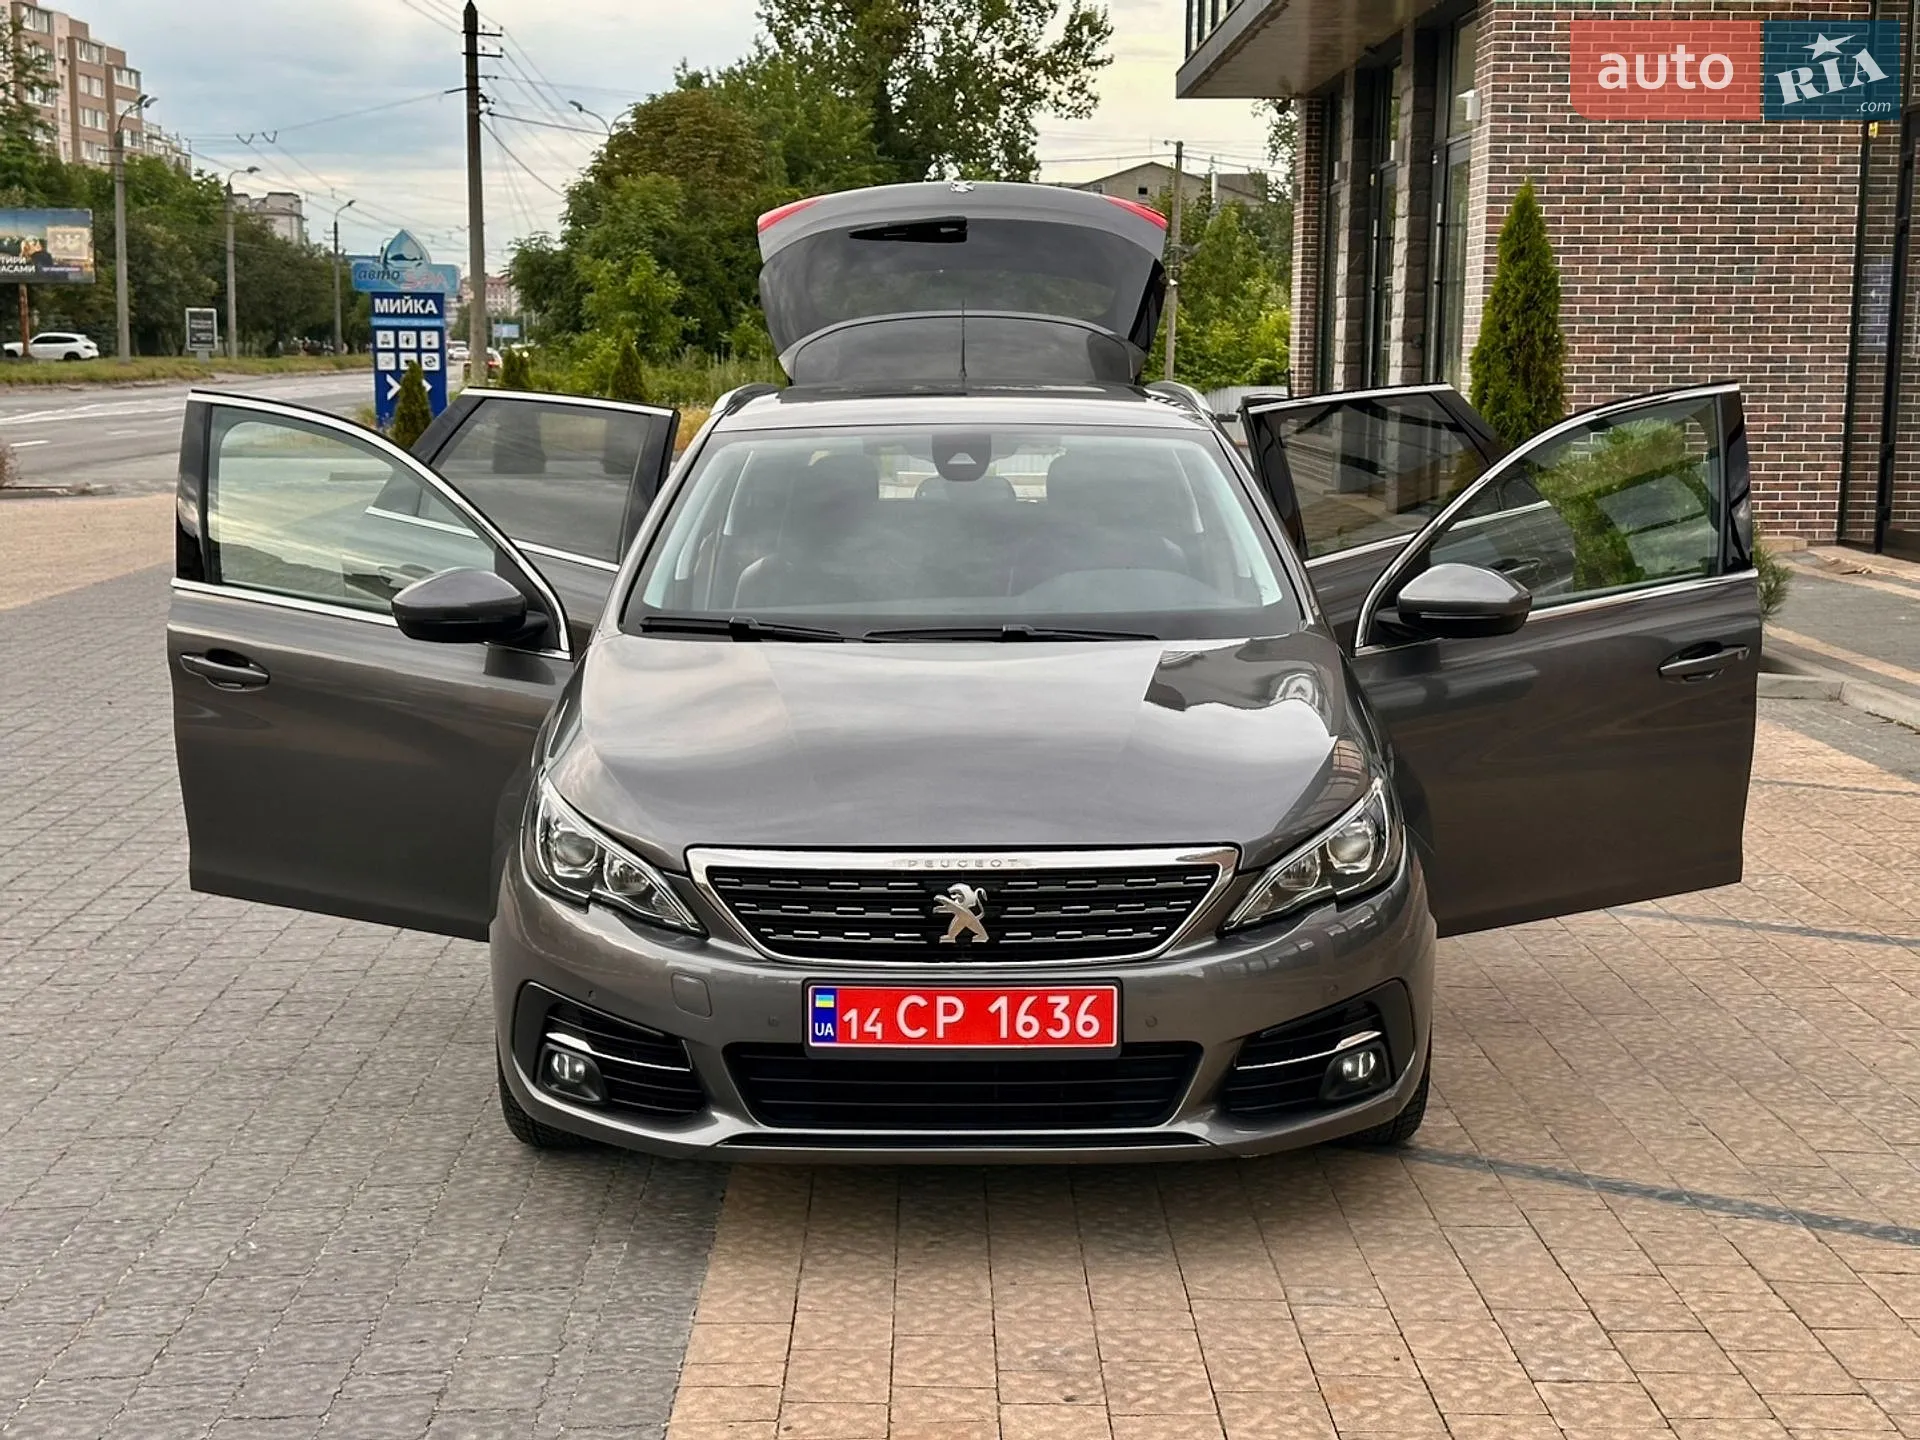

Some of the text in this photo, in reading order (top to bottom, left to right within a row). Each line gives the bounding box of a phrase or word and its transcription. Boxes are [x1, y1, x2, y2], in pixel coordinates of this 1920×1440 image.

[358, 269, 400, 281] авто
[374, 295, 438, 315] МИЙКА
[907, 858, 1018, 869] PEUGEOT
[842, 994, 1101, 1040] 14 CP 1636
[814, 1022, 834, 1037] UA
